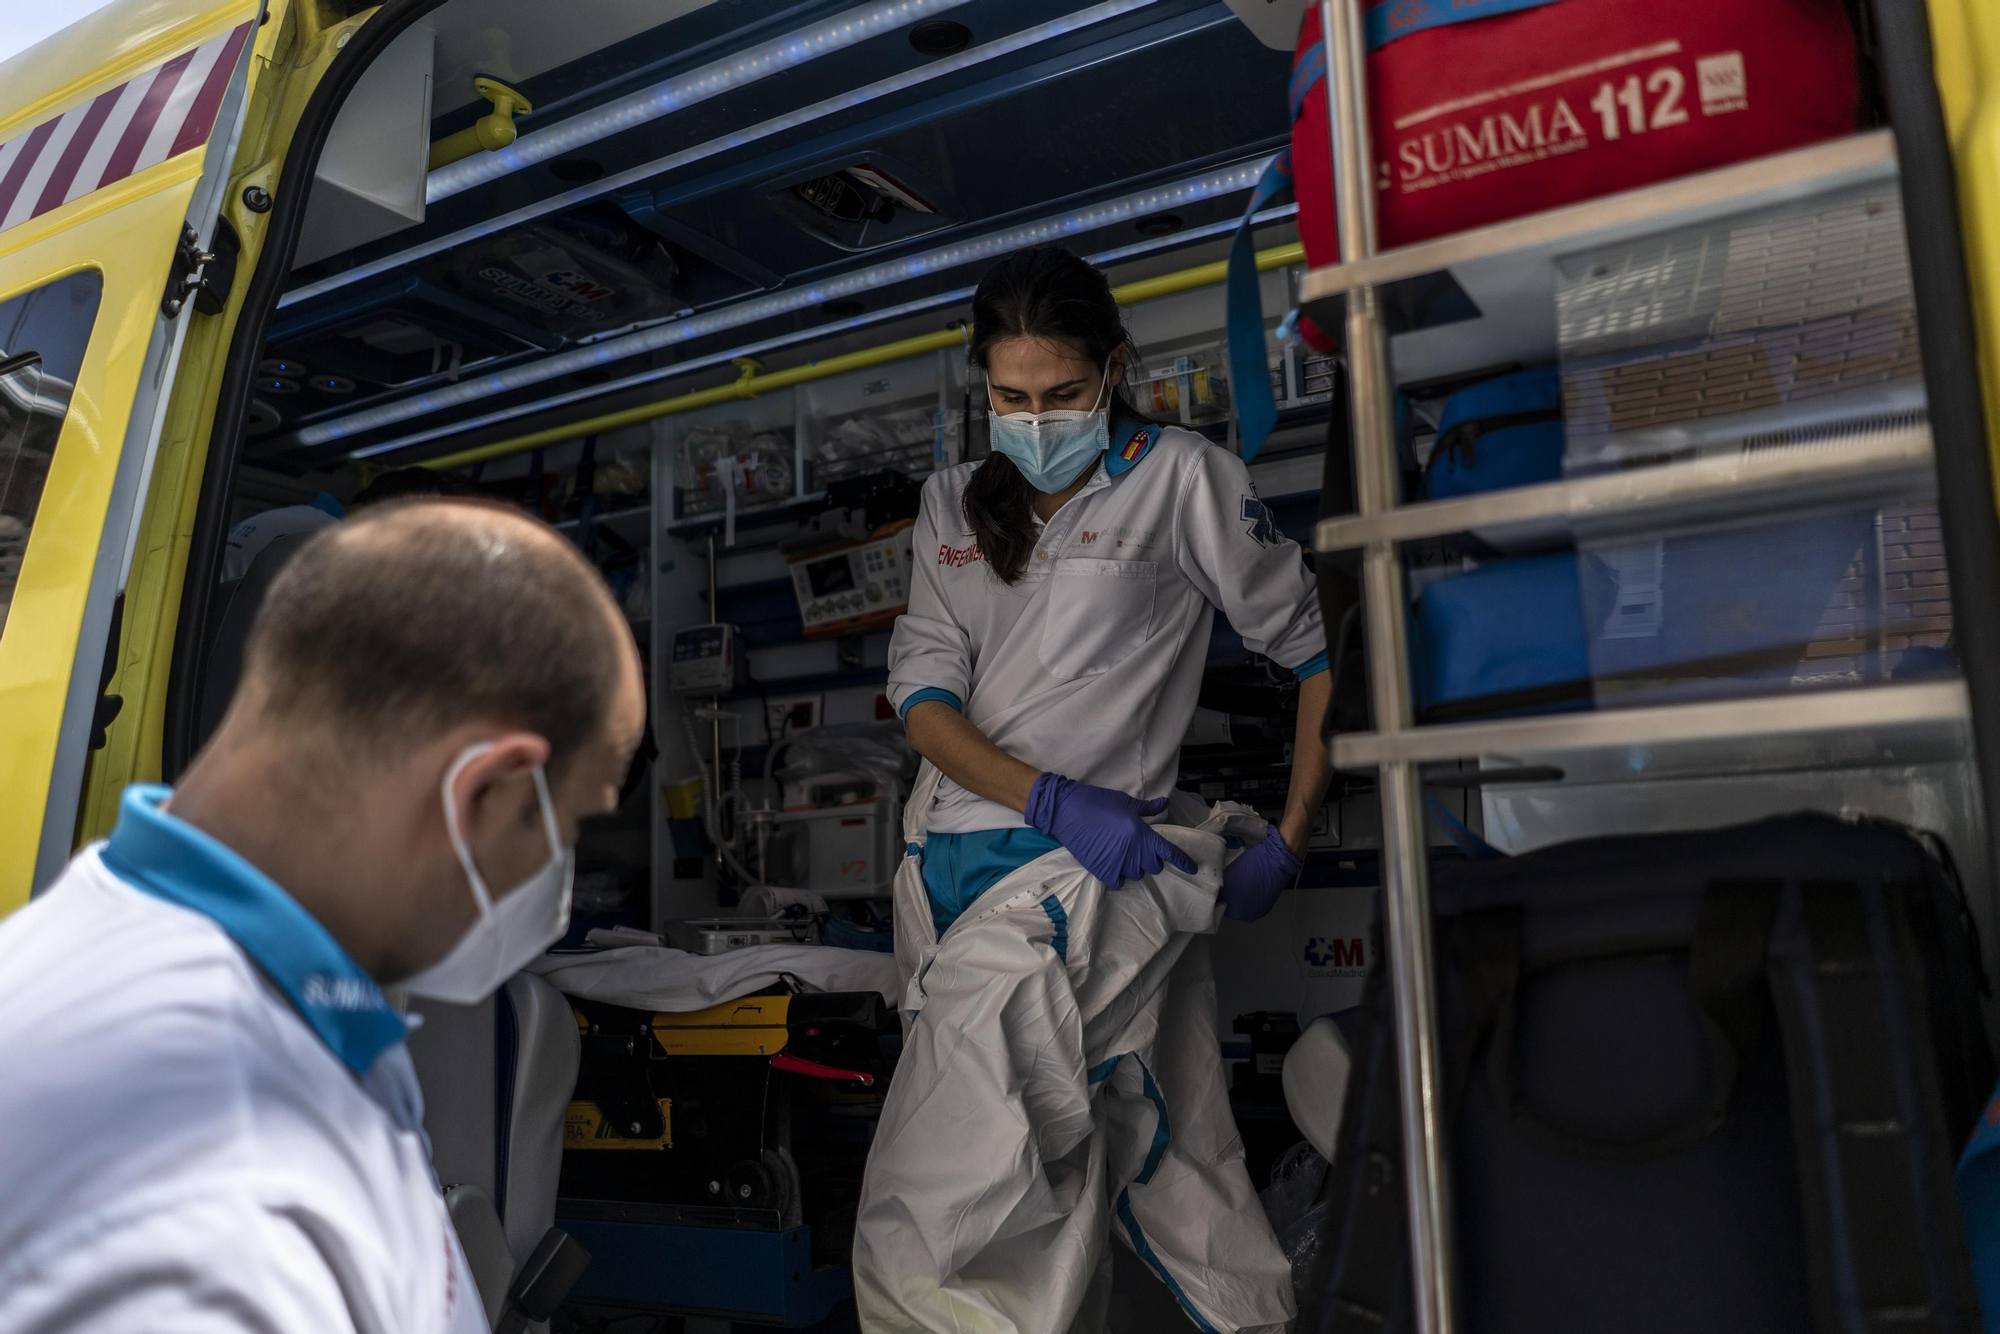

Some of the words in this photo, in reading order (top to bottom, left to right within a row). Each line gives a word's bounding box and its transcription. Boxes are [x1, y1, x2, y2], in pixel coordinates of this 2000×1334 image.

[1399, 97, 1586, 181] SUMMA
[1590, 67, 1689, 140] 112
[1081, 531, 1098, 544] M
